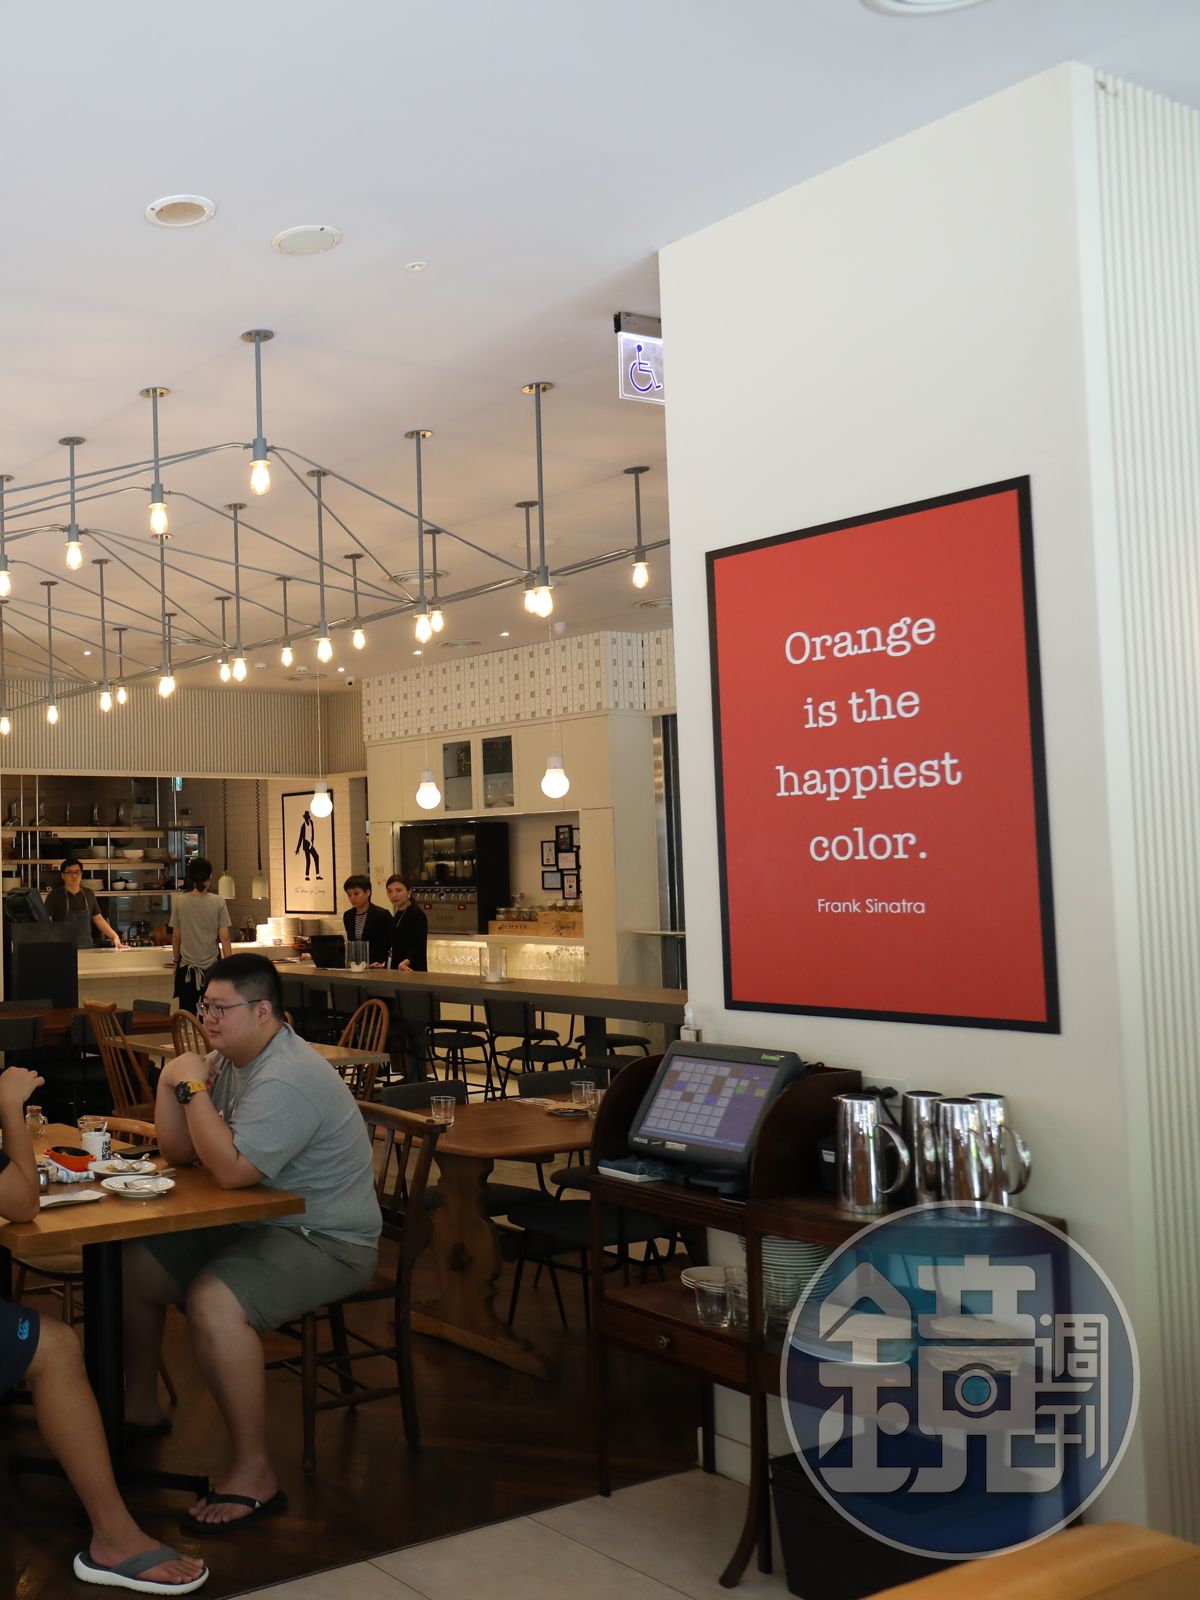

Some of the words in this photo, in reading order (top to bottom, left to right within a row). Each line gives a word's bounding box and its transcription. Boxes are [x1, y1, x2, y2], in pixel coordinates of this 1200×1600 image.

[784, 616, 936, 665] Orange
[803, 696, 838, 729] is
[847, 687, 921, 724] the
[775, 751, 963, 802] happiest
[809, 826, 928, 862] color.
[817, 898, 861, 913] Frank
[865, 898, 926, 914] Sinatra
